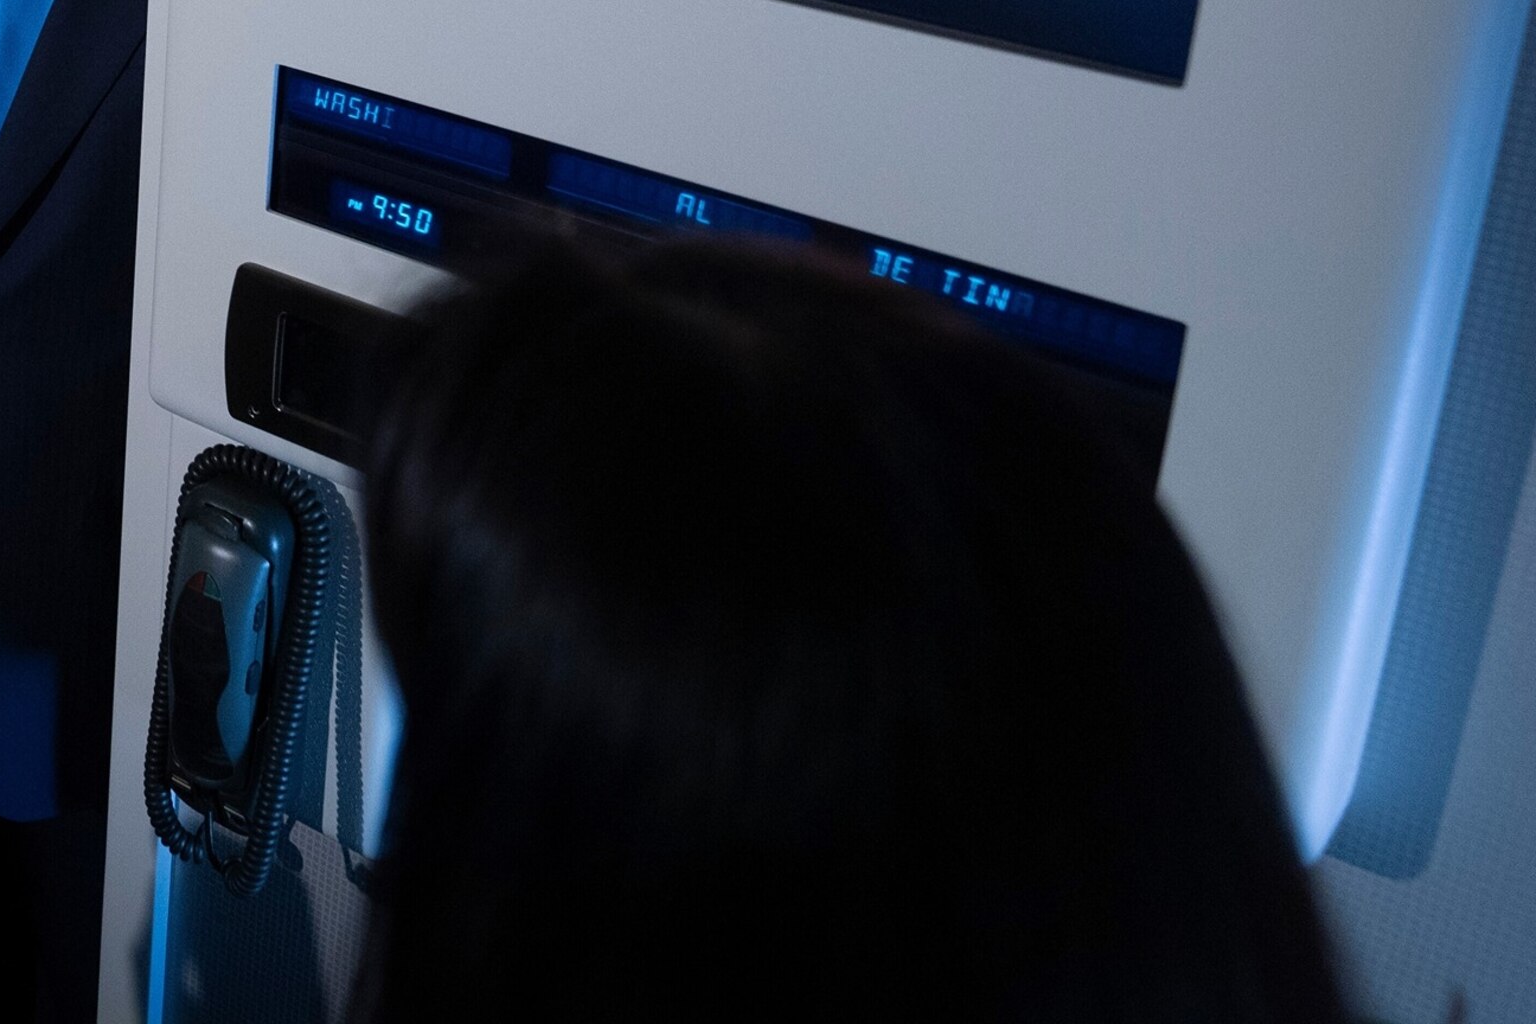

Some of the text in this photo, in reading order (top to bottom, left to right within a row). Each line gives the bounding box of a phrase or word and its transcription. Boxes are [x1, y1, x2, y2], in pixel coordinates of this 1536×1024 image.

[347, 194, 433, 235] PM 9:50
[674, 191, 711, 225] AL
